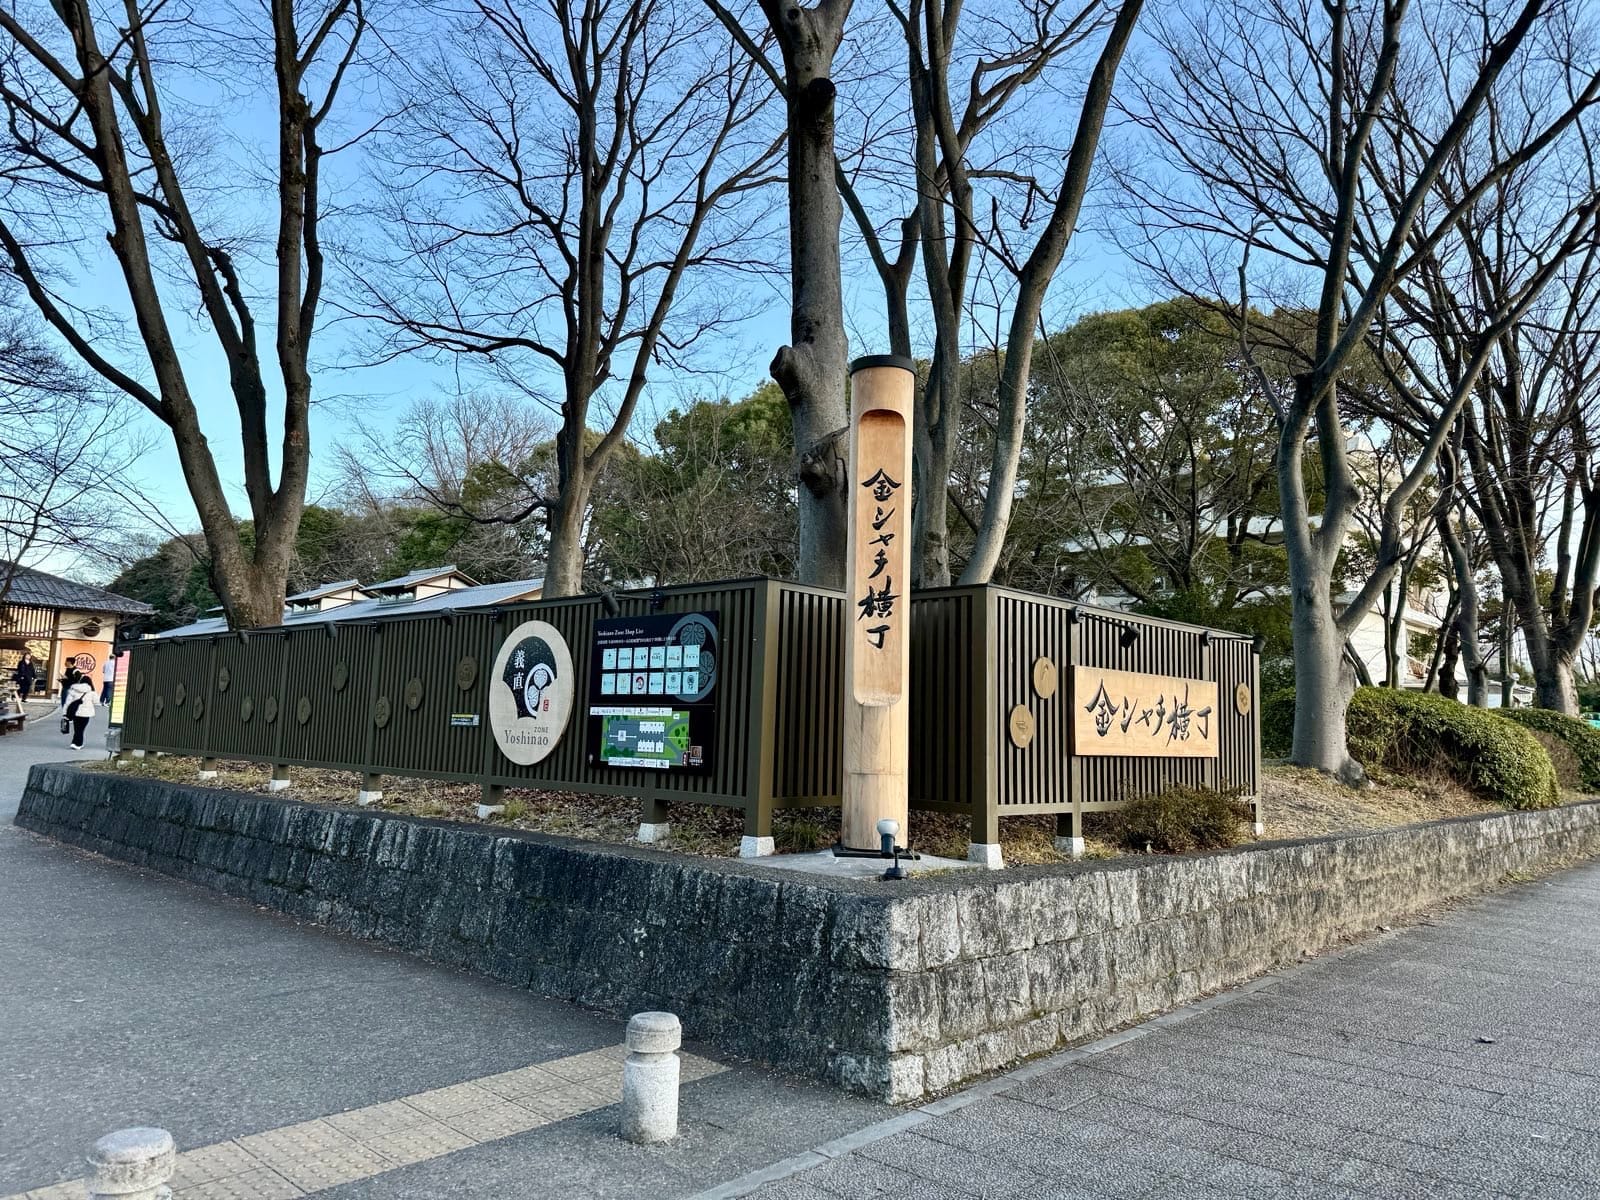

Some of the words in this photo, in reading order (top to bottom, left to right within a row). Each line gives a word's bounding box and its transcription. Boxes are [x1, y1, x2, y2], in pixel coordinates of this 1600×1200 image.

[858, 468, 901, 649] 金シャチ横丁
[513, 650, 526, 690] 義直
[504, 729, 549, 746] Yoshinao
[1084, 678, 1212, 747] 金シャチ横丁
